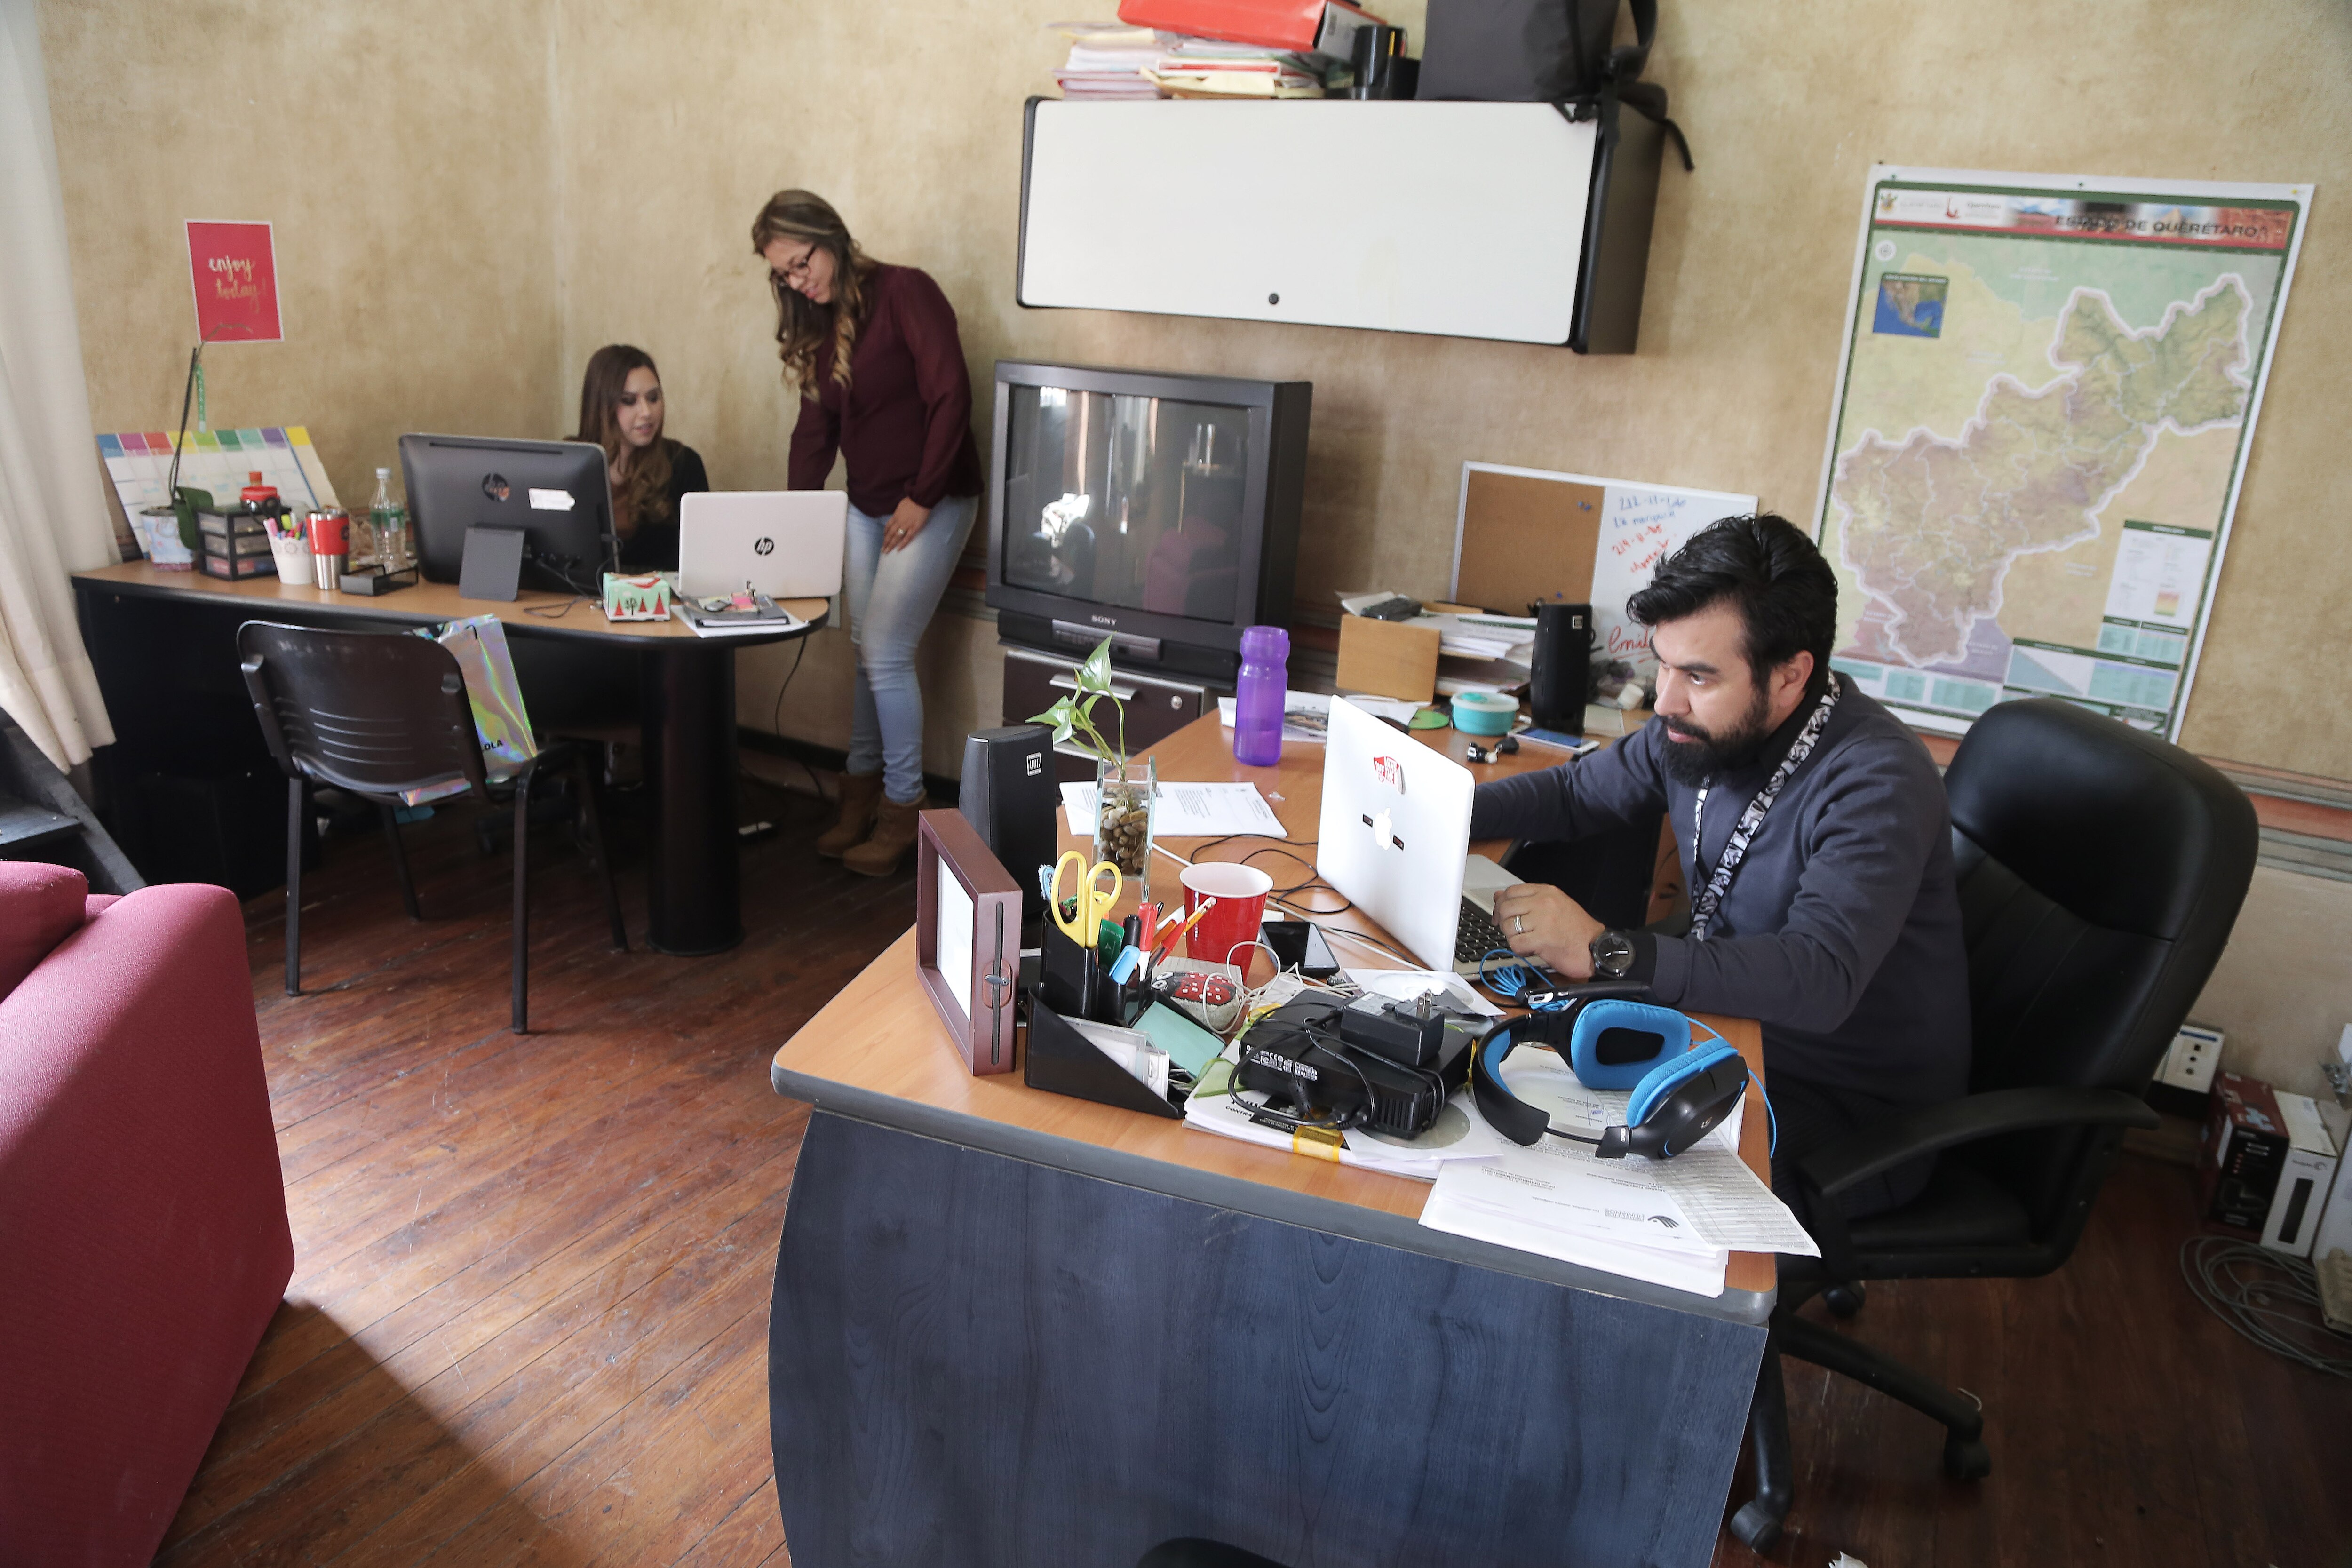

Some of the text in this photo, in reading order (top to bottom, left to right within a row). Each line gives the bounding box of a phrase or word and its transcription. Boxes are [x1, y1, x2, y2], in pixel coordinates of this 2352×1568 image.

[2125, 219, 2147, 231] DE
[2153, 219, 2258, 239] QUERÉTARO
[208, 255, 256, 282] enjoy
[755, 537, 773, 556] hp
[1091, 614, 1117, 626] SONY
[483, 739, 503, 752] OLA
[1384, 756, 1398, 771] VANS
[1385, 768, 1395, 785] THE
[1225, 1106, 1253, 1117] CONTRA
